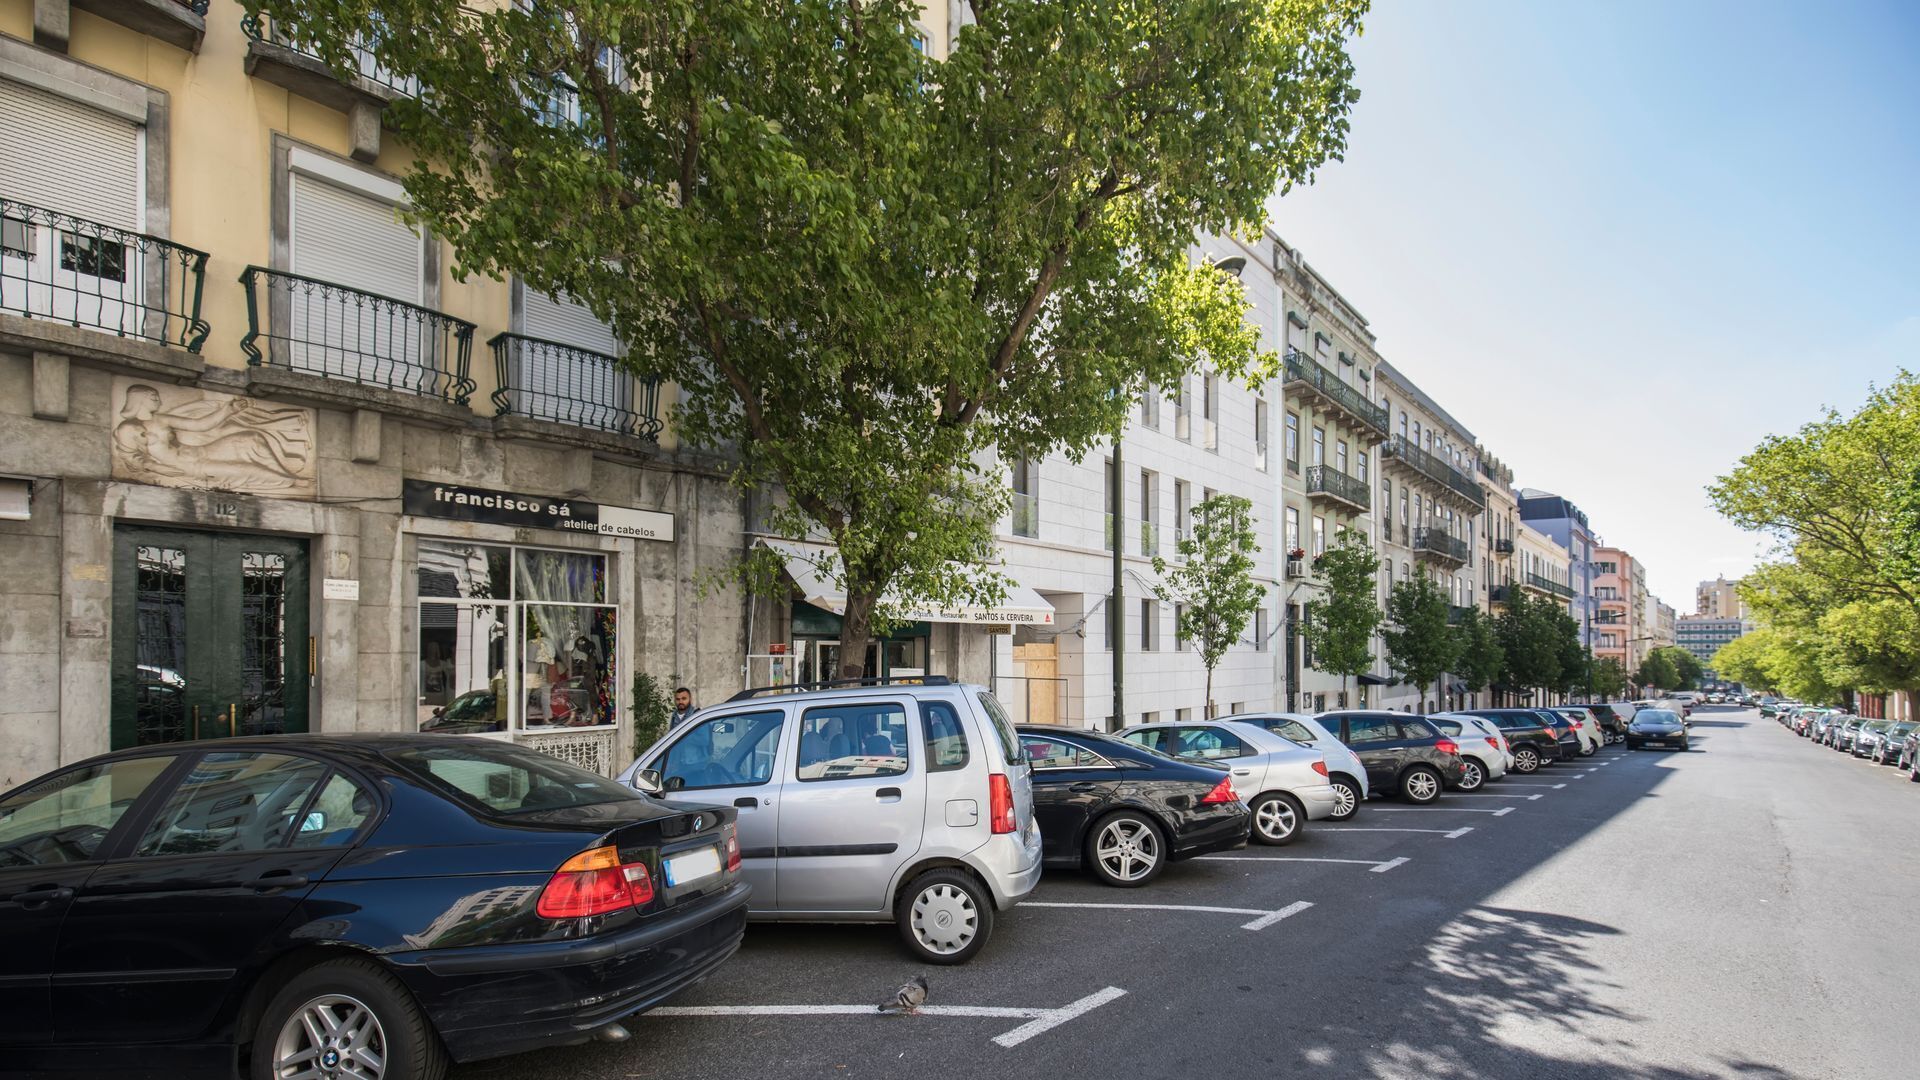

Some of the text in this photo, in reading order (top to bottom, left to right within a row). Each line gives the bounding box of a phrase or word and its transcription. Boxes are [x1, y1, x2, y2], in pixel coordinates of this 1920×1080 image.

[434, 487, 570, 516] francisco sá
[216, 504, 236, 515] 112
[563, 519, 655, 537] atelier de cabelos
[974, 612, 998, 621] SANTOS
[1006, 613, 1034, 622] CERVEIRA
